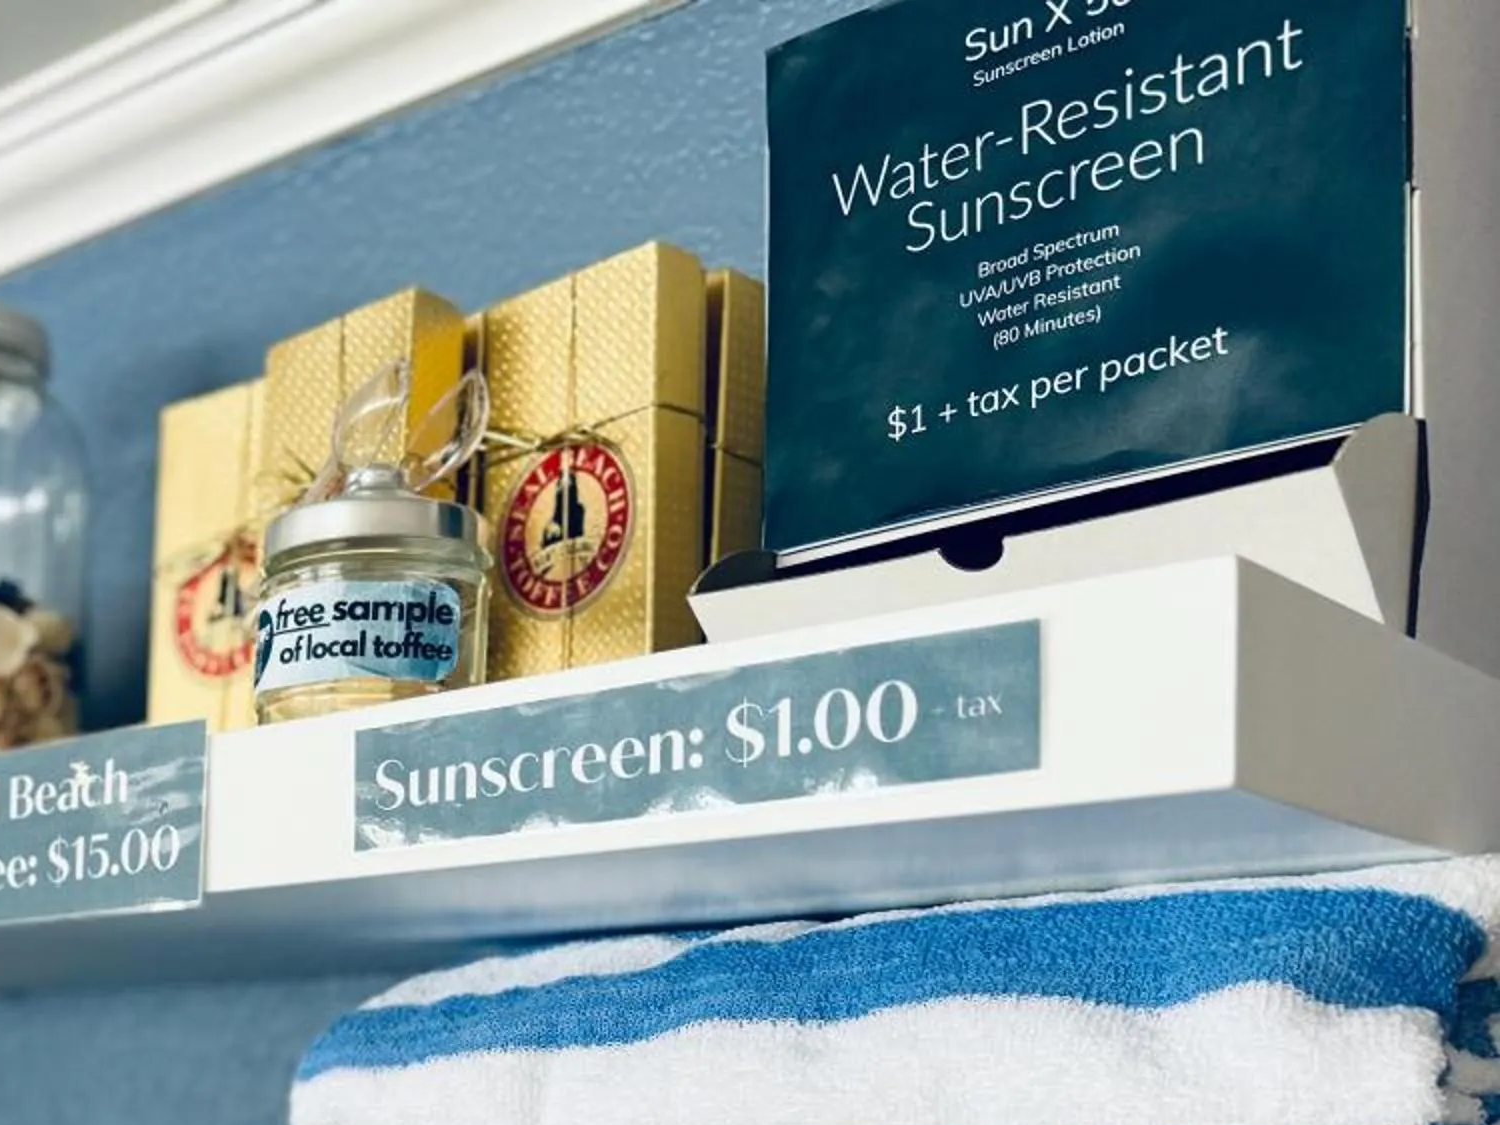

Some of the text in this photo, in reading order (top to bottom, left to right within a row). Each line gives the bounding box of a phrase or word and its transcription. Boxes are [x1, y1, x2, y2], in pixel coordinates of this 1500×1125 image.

[964, 16, 1033, 62] Sun
[1045, 0, 1072, 33] X
[972, 22, 1126, 87] Sunscreen Lotion
[831, 18, 1304, 216] Water-Resistant
[905, 126, 1204, 253] Sunscreen
[959, 244, 1142, 308] UVA/UVB Protection
[977, 224, 1120, 279] Broad Spectrum
[977, 274, 1122, 327] Water Resistant
[993, 304, 1102, 351] (80 Minutes)
[887, 327, 1230, 442] $1 + tax per packet
[274, 591, 455, 631] free sample
[279, 630, 452, 664] of local toffee
[375, 727, 705, 811] Sunscreen:
[725, 678, 919, 768] $1.00
[956, 689, 1005, 720] tax
[9, 757, 128, 821] Beach
[47, 823, 180, 888] $15.00
